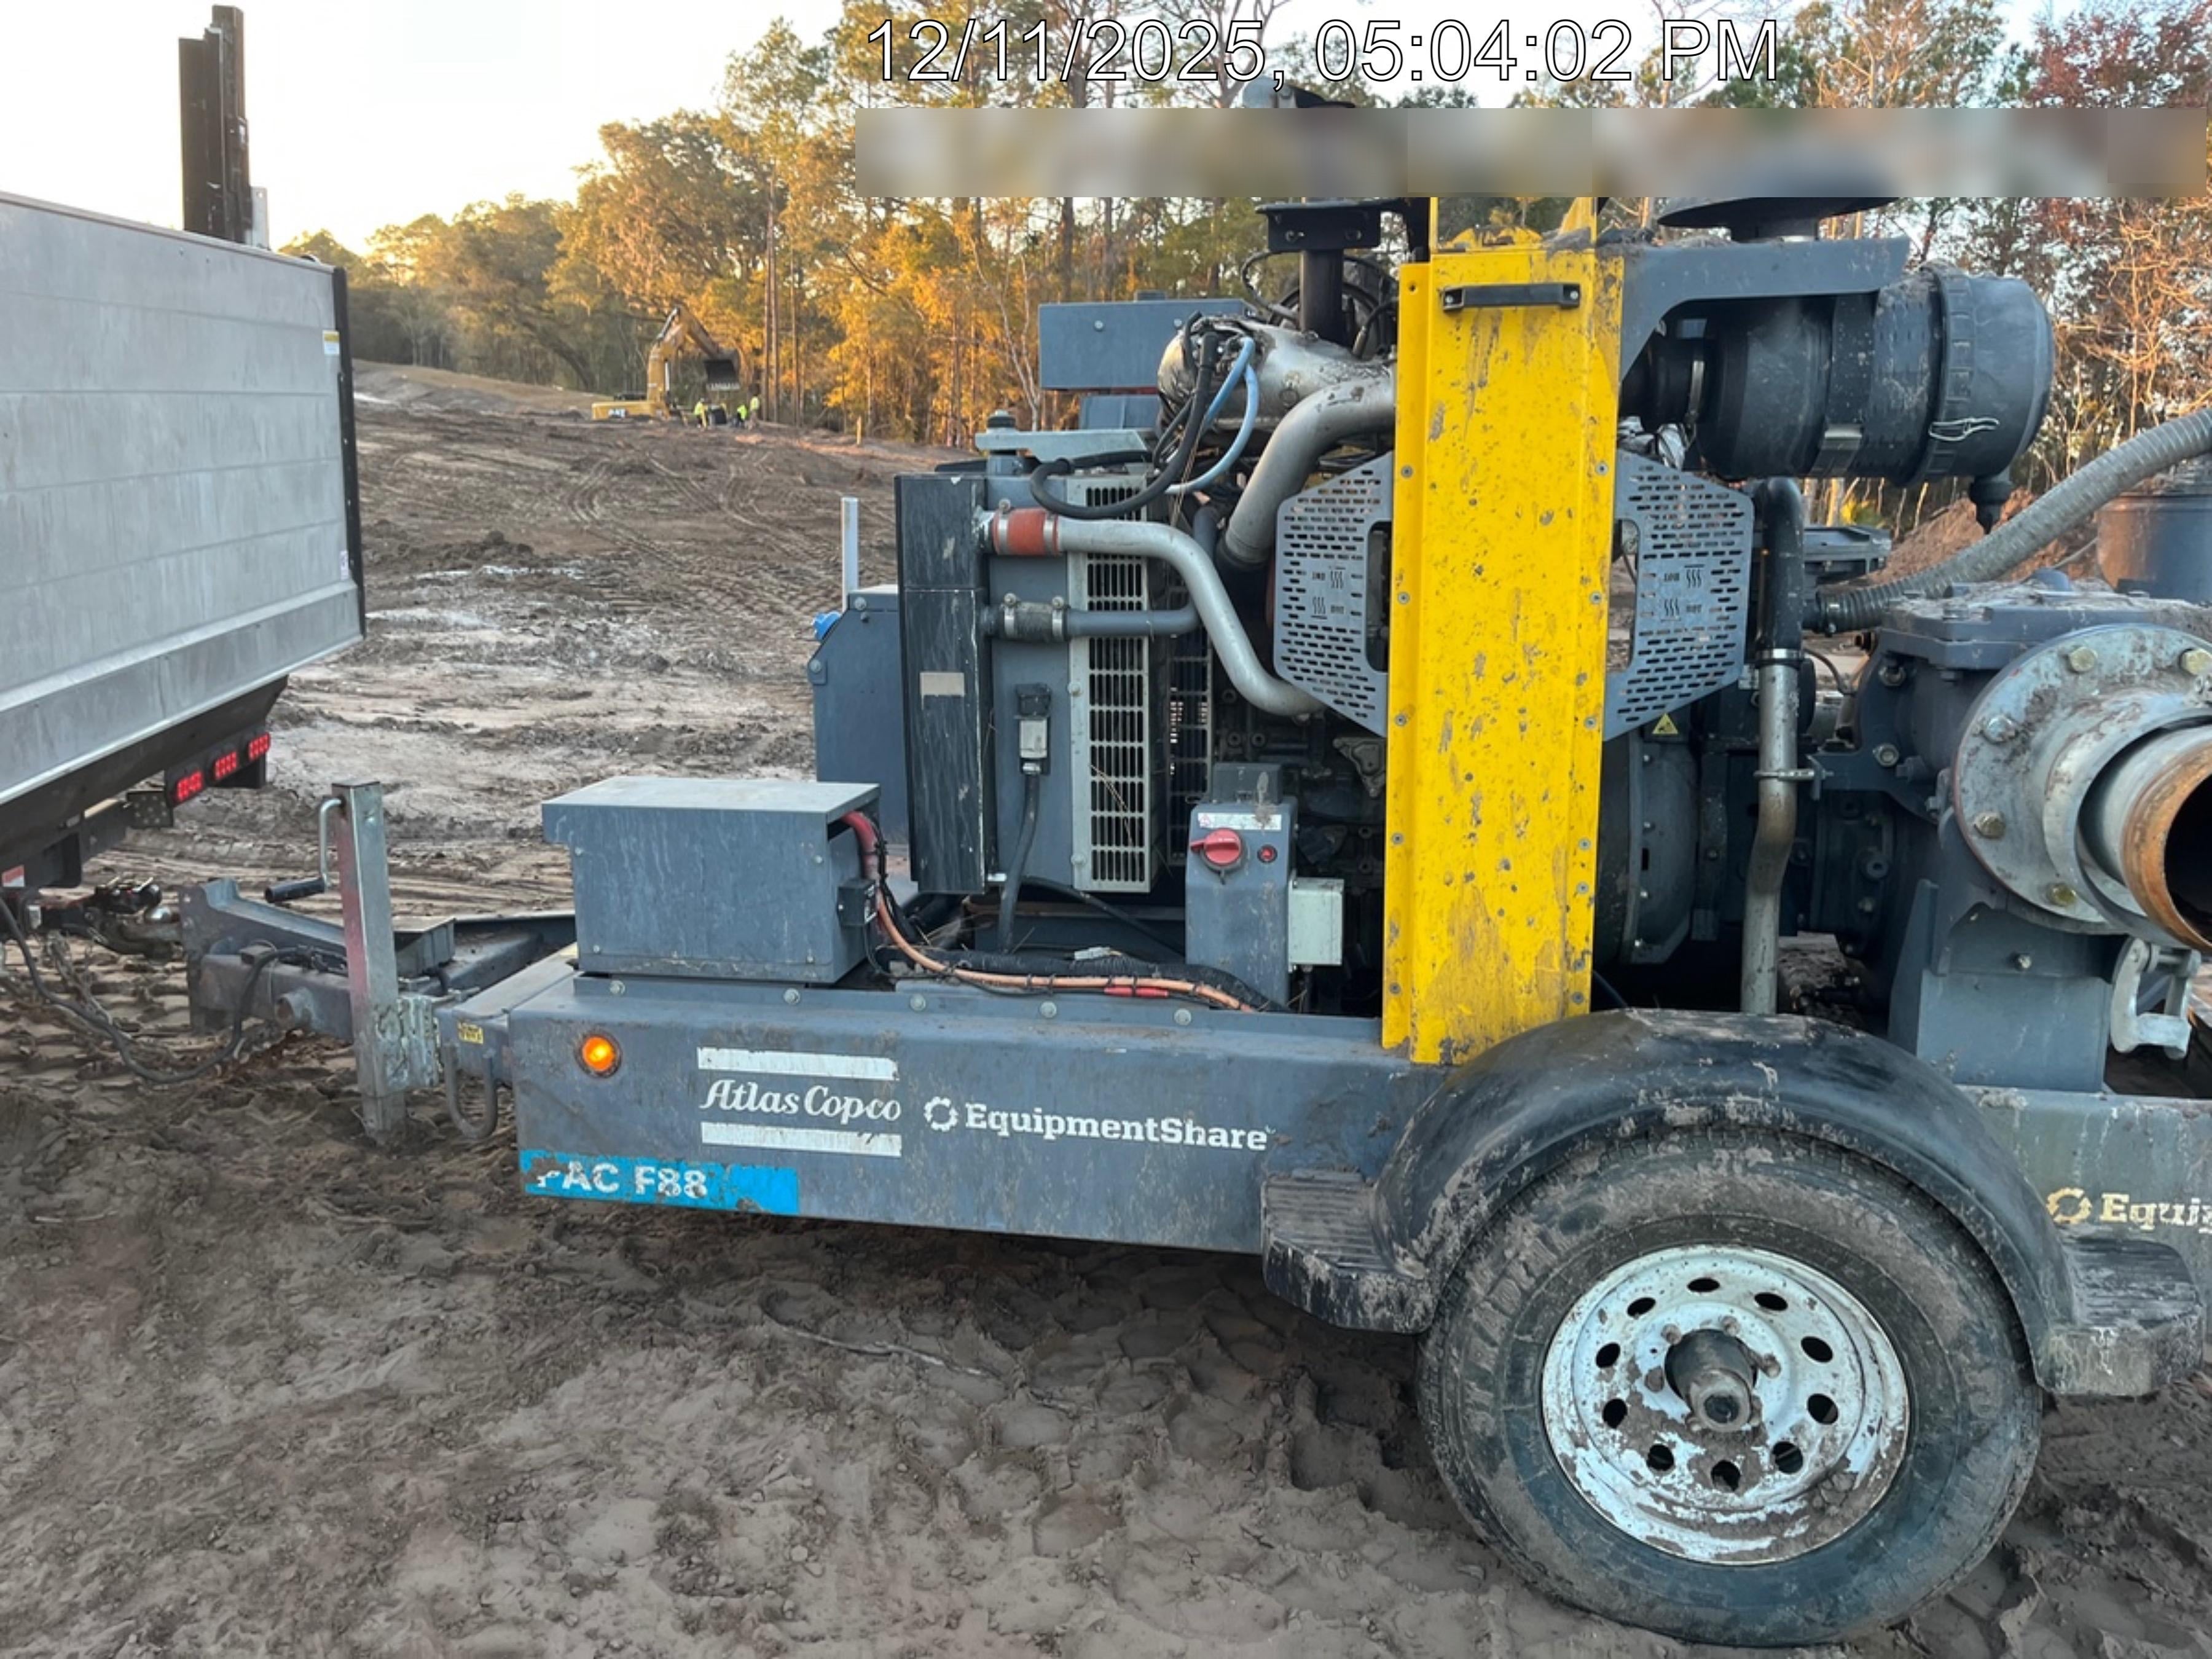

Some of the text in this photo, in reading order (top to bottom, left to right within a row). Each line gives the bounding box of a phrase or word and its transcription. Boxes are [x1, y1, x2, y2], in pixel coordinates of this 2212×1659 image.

[699, 1078, 901, 1125] Atlas Copco
[964, 1103, 1268, 1151] EquipmentShare
[635, 1166, 707, 1198] F88
